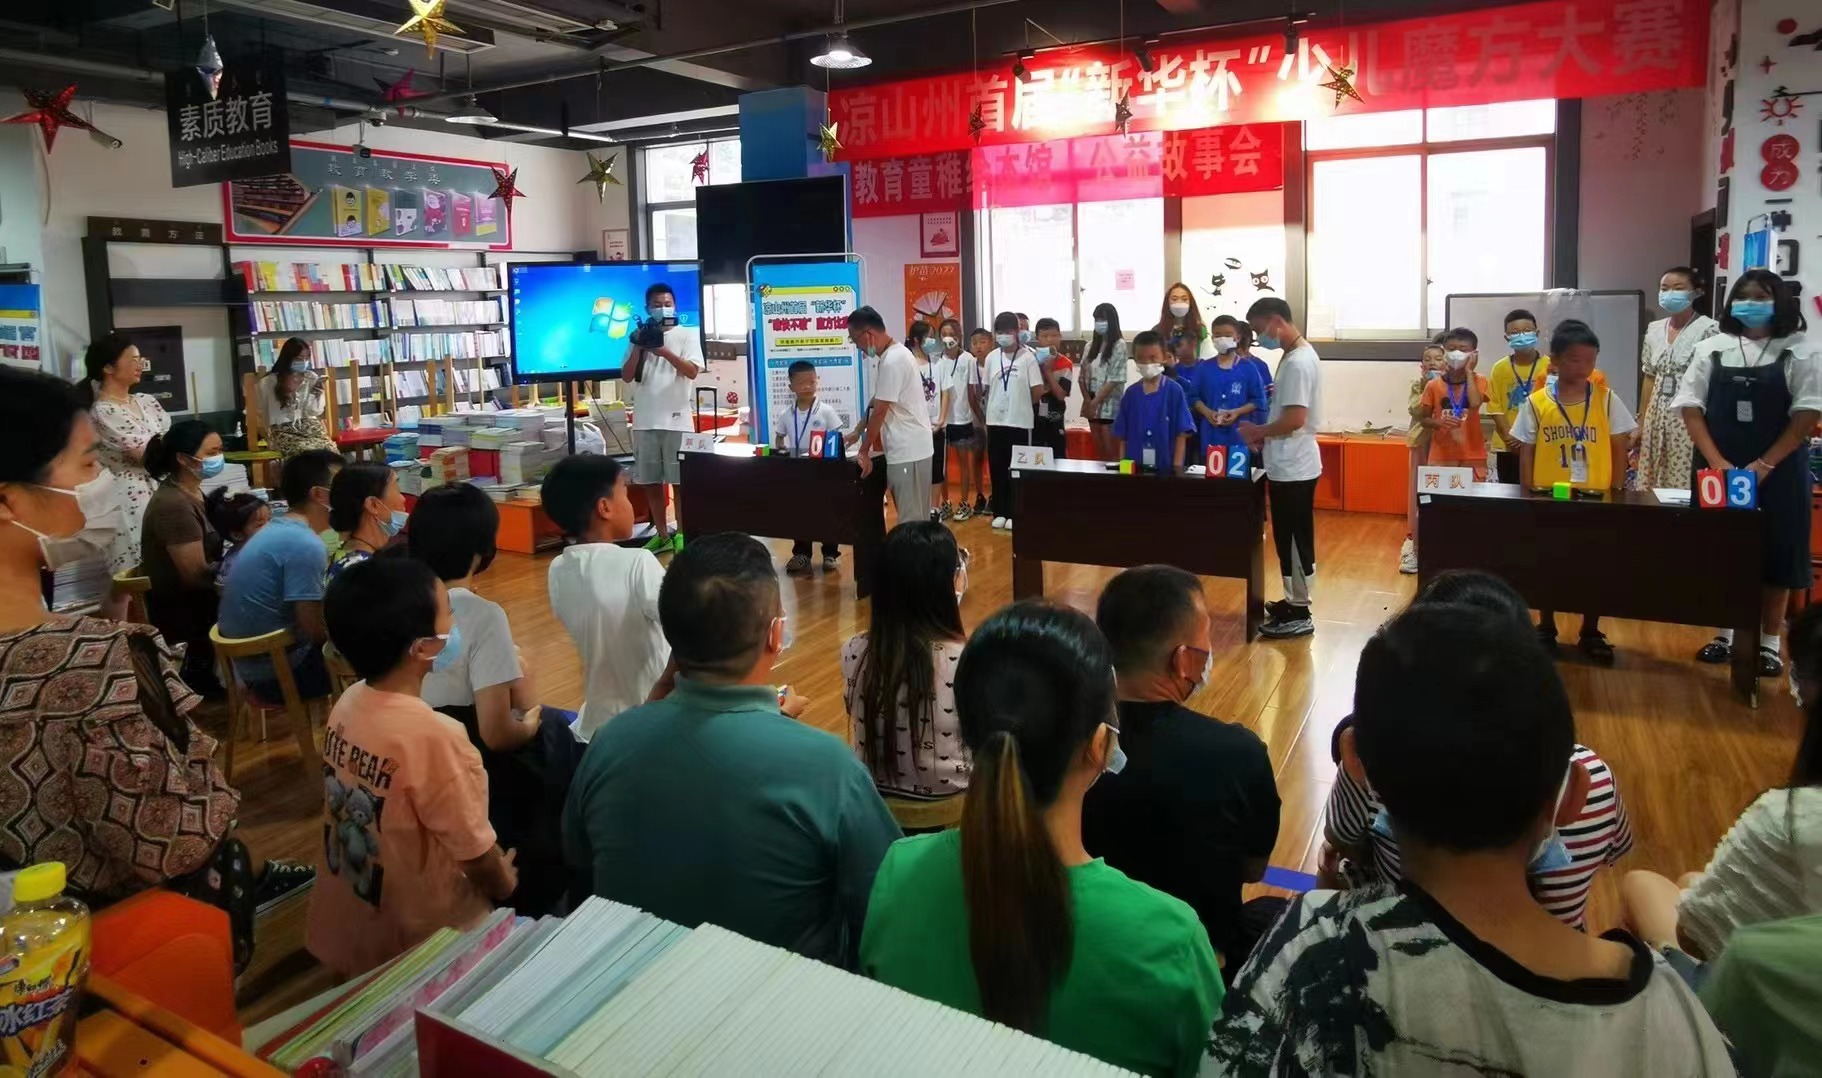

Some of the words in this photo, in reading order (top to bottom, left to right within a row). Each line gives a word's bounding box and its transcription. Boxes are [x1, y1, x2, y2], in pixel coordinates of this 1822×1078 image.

[180, 91, 274, 141] 素质教育
[220, 142, 256, 161] Education
[256, 139, 279, 156] Books
[1208, 450, 1247, 476] 02
[1701, 476, 1752, 505] 03
